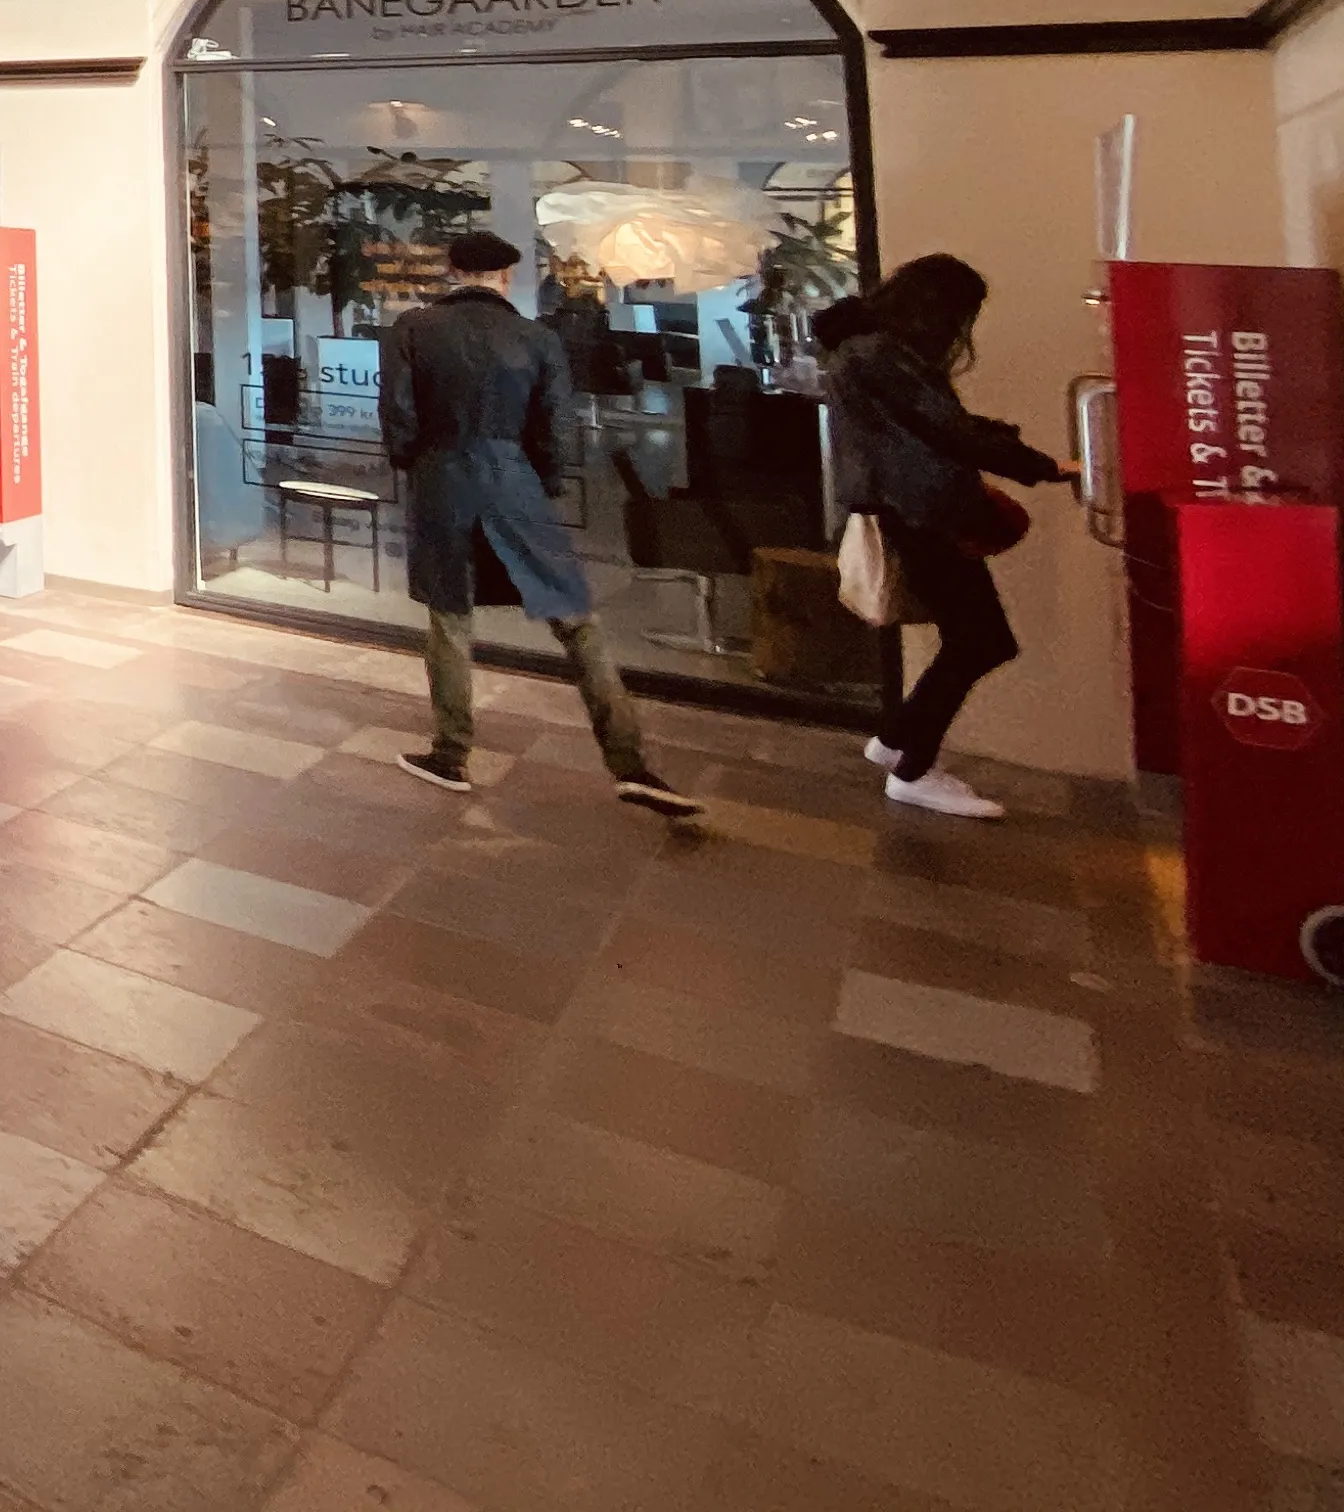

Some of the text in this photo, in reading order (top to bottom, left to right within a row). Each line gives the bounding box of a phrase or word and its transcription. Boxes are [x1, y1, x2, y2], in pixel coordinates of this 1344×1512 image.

[8, 266, 16, 322] Tickets
[17, 264, 26, 333] Billetter
[11, 347, 19, 386] Train
[1181, 331, 1223, 433] Tickets
[327, 404, 356, 419] 399
[1231, 331, 1279, 488] Billetter &
[10, 391, 21, 485] departures
[1189, 442, 1228, 464] &
[1227, 691, 1307, 725] DSB
